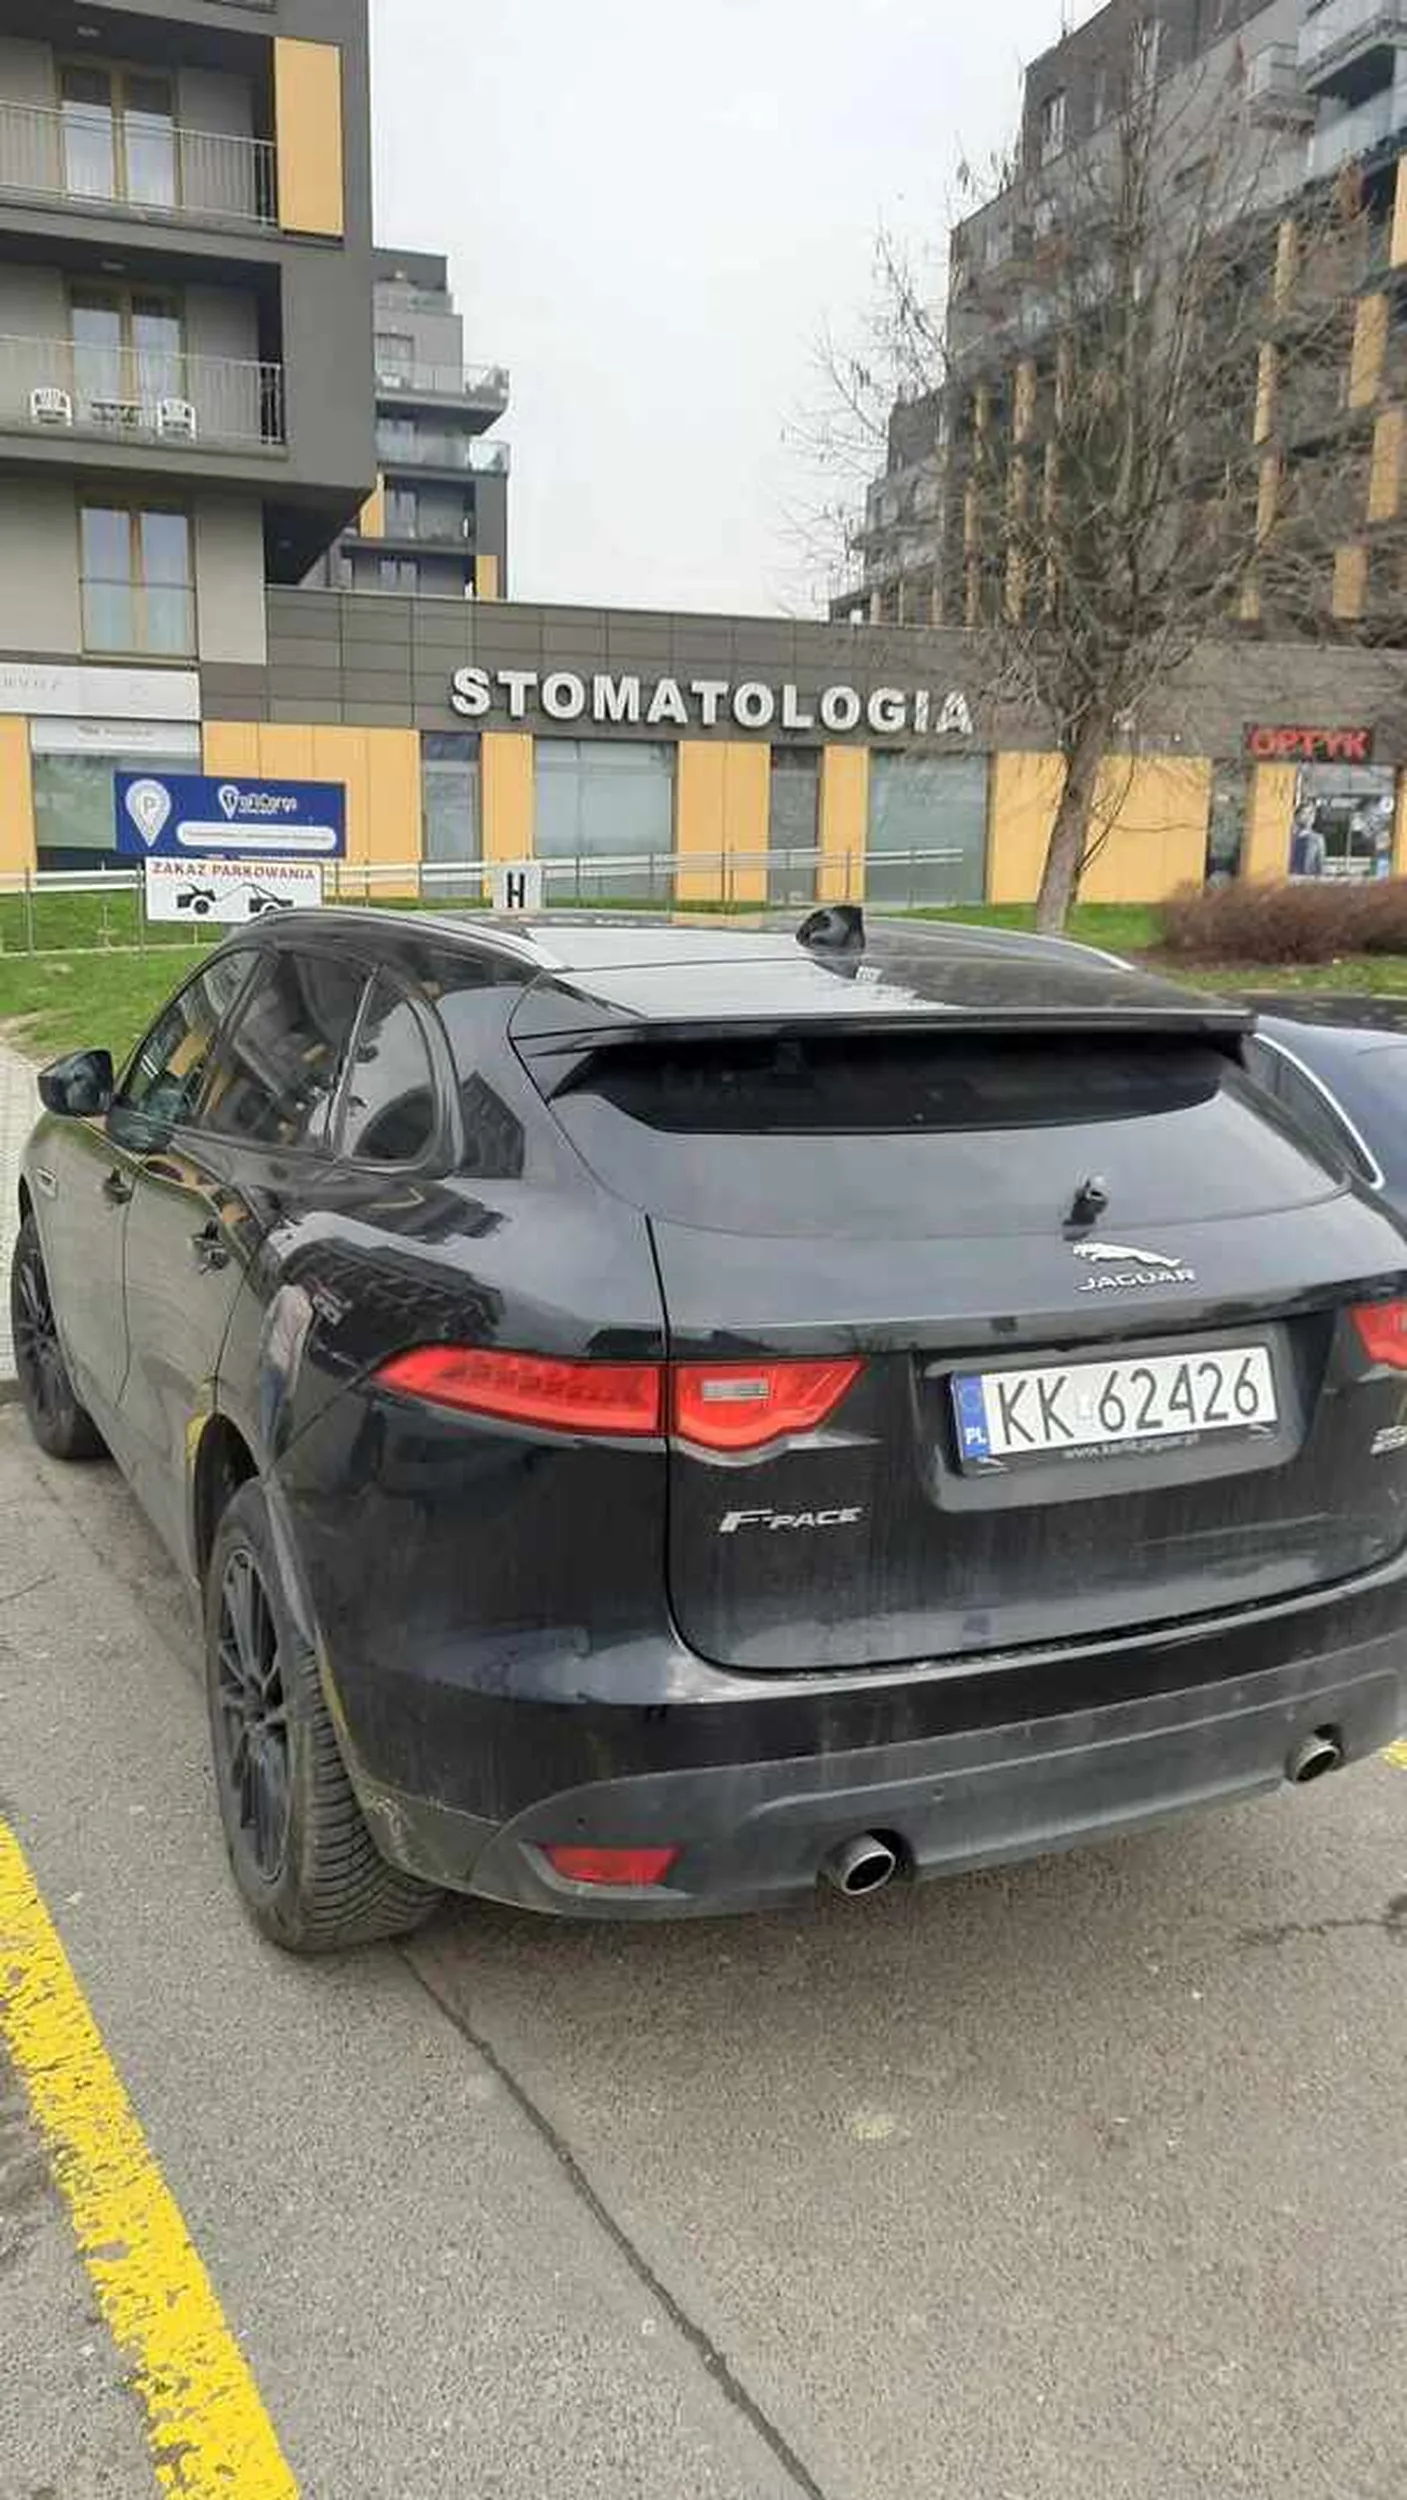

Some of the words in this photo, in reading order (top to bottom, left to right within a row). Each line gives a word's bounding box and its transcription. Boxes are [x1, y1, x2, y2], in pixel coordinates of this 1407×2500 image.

[451, 667, 974, 735] STOMATOLOGIA
[1252, 728, 1368, 760] OPTYK
[152, 861, 206, 876] ZAKAZ
[211, 862, 316, 880] PARKOWANIA
[506, 871, 526, 909] H
[1078, 1269, 1196, 1291] JAGUAR
[997, 1375, 1075, 1446] KK
[1099, 1356, 1260, 1433] 62426
[965, 1427, 987, 1444] PL
[719, 1507, 863, 1532] F-PACE
